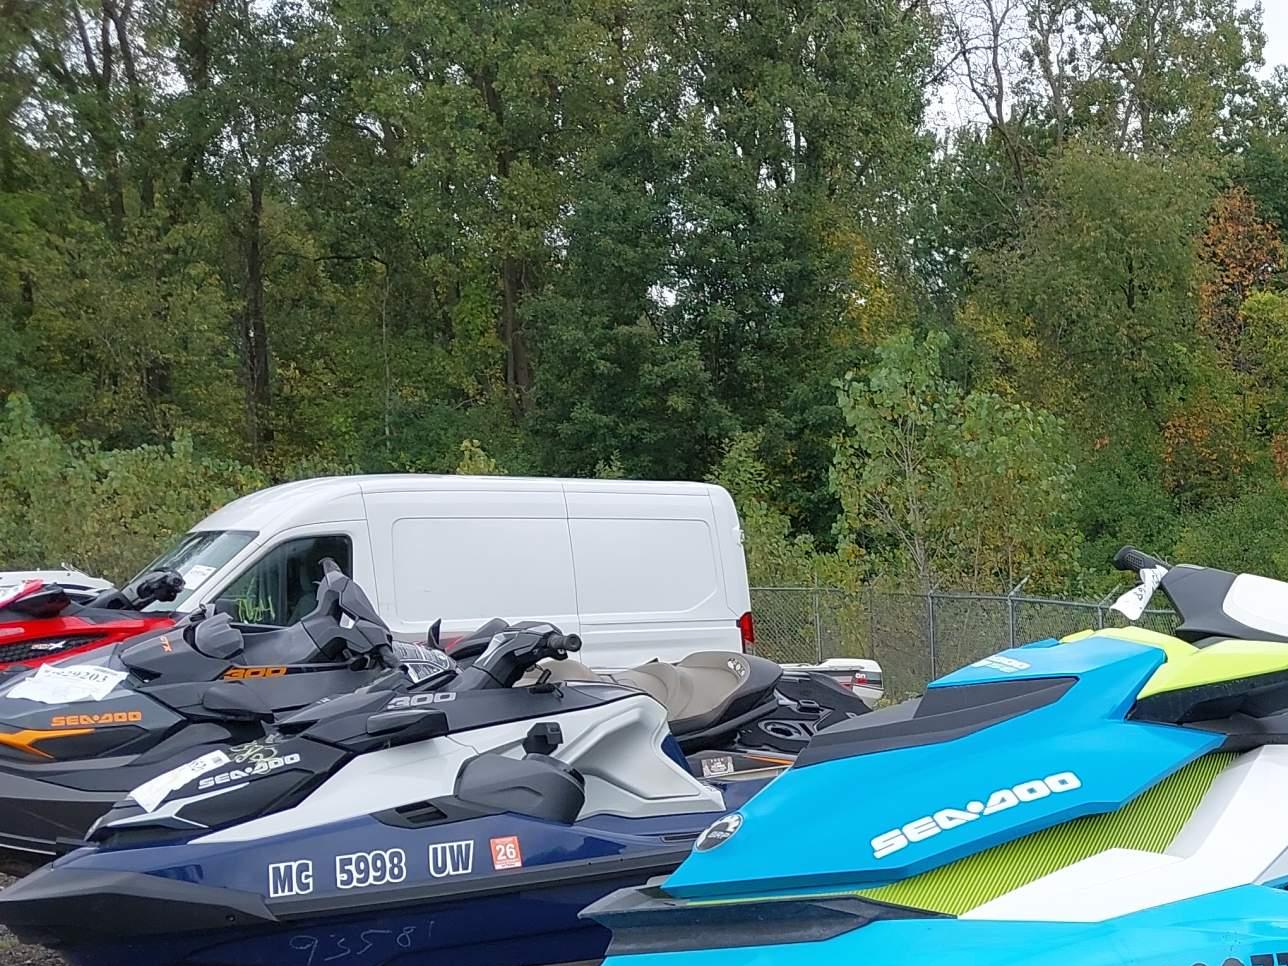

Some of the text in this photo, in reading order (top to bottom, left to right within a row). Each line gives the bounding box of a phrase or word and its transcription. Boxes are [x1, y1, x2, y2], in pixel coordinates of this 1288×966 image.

[223, 666, 288, 680] 300
[387, 692, 457, 711] 300
[495, 843, 517, 861] 26
[268, 839, 475, 898] MC 5998 UW
